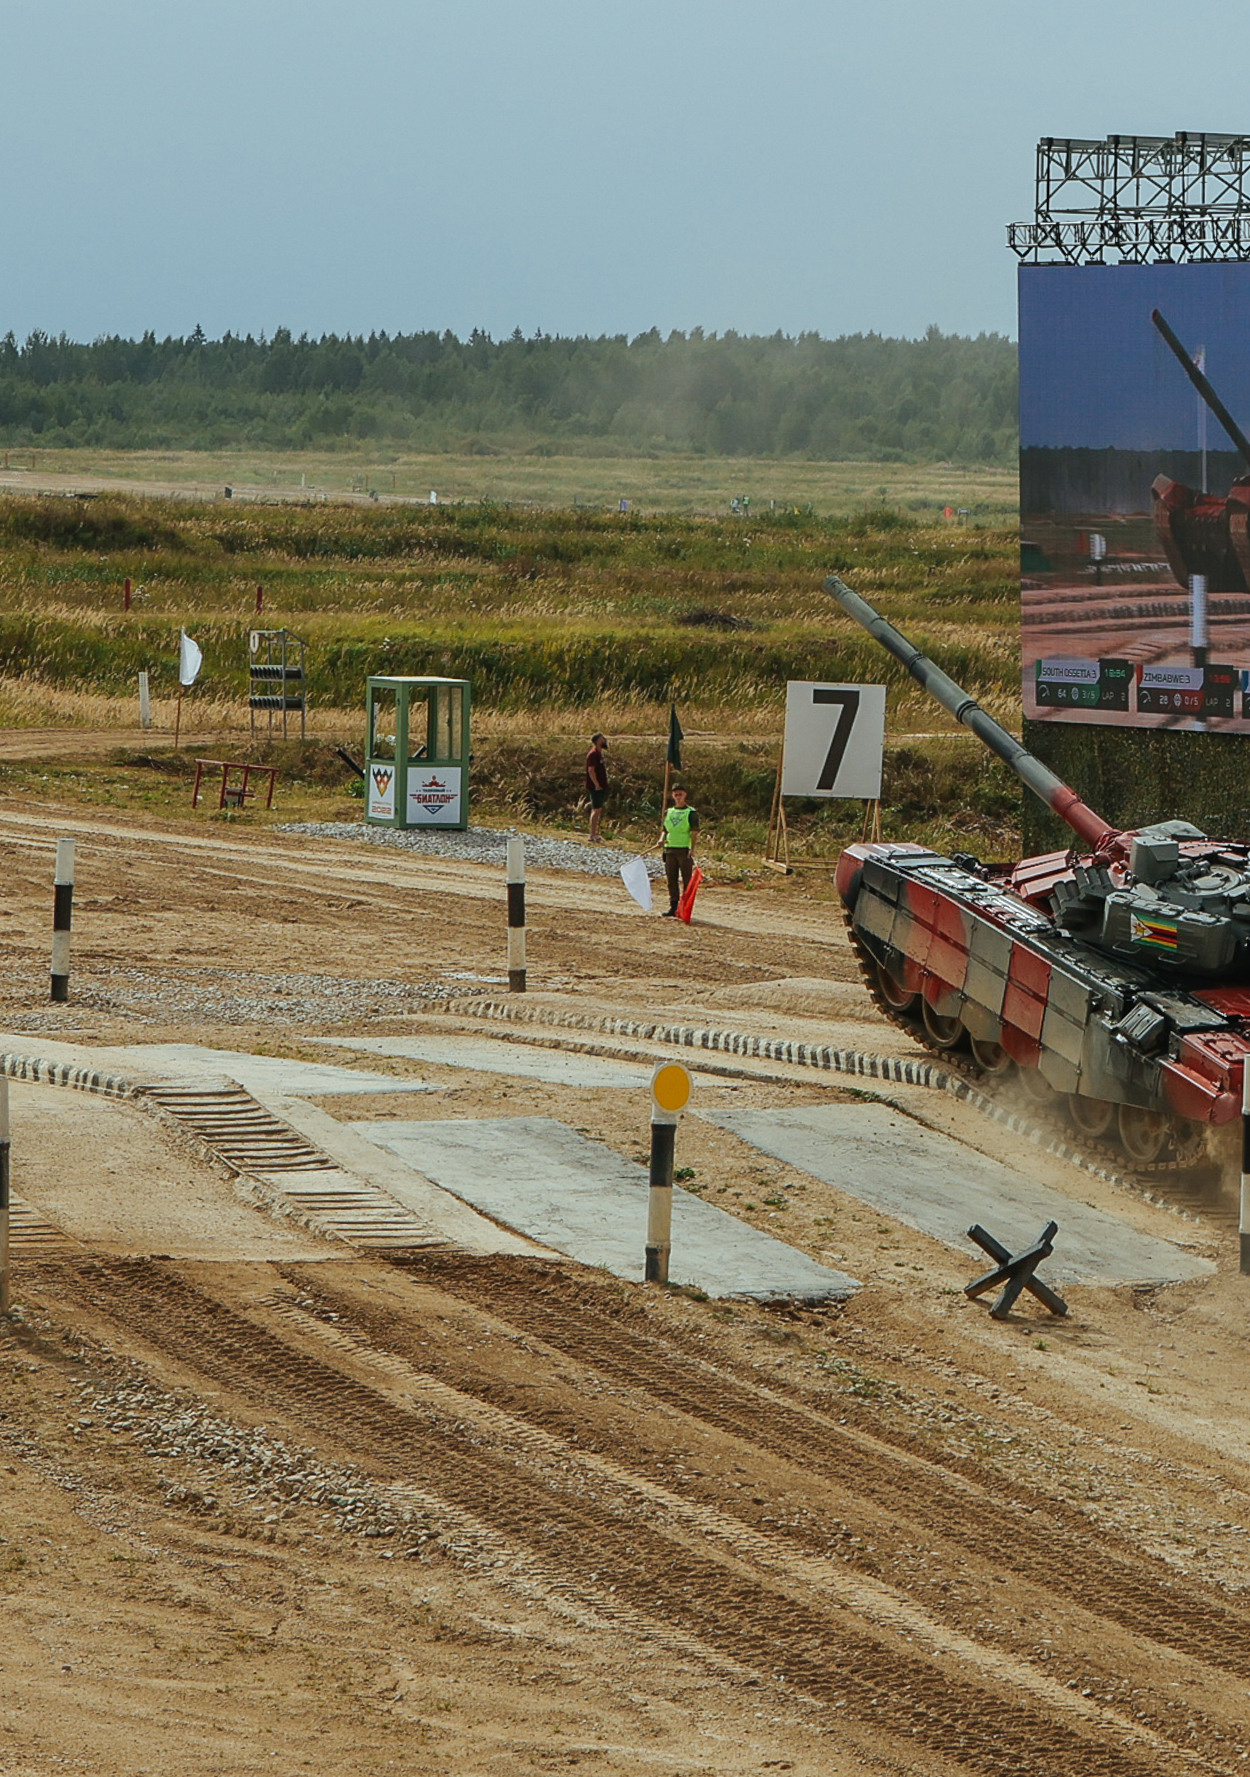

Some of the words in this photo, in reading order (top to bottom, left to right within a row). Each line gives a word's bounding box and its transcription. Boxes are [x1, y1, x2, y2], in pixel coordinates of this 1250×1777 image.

[1042, 667, 1063, 677] SOUTH
[1064, 669, 1091, 678] OSSETIA
[1091, 670, 1097, 679] 3
[1143, 672, 1185, 684] ZIMBABWE
[1185, 674, 1191, 684] 3
[1102, 691, 1114, 701] LAP
[1159, 695, 1169, 705] 28
[1184, 696, 1199, 706] 0/5
[1206, 697, 1219, 706] LAP
[1225, 698, 1231, 707] 2
[813, 689, 860, 790] 7
[417, 794, 451, 804] БИАТЛОН
[371, 806, 392, 815] 2022
